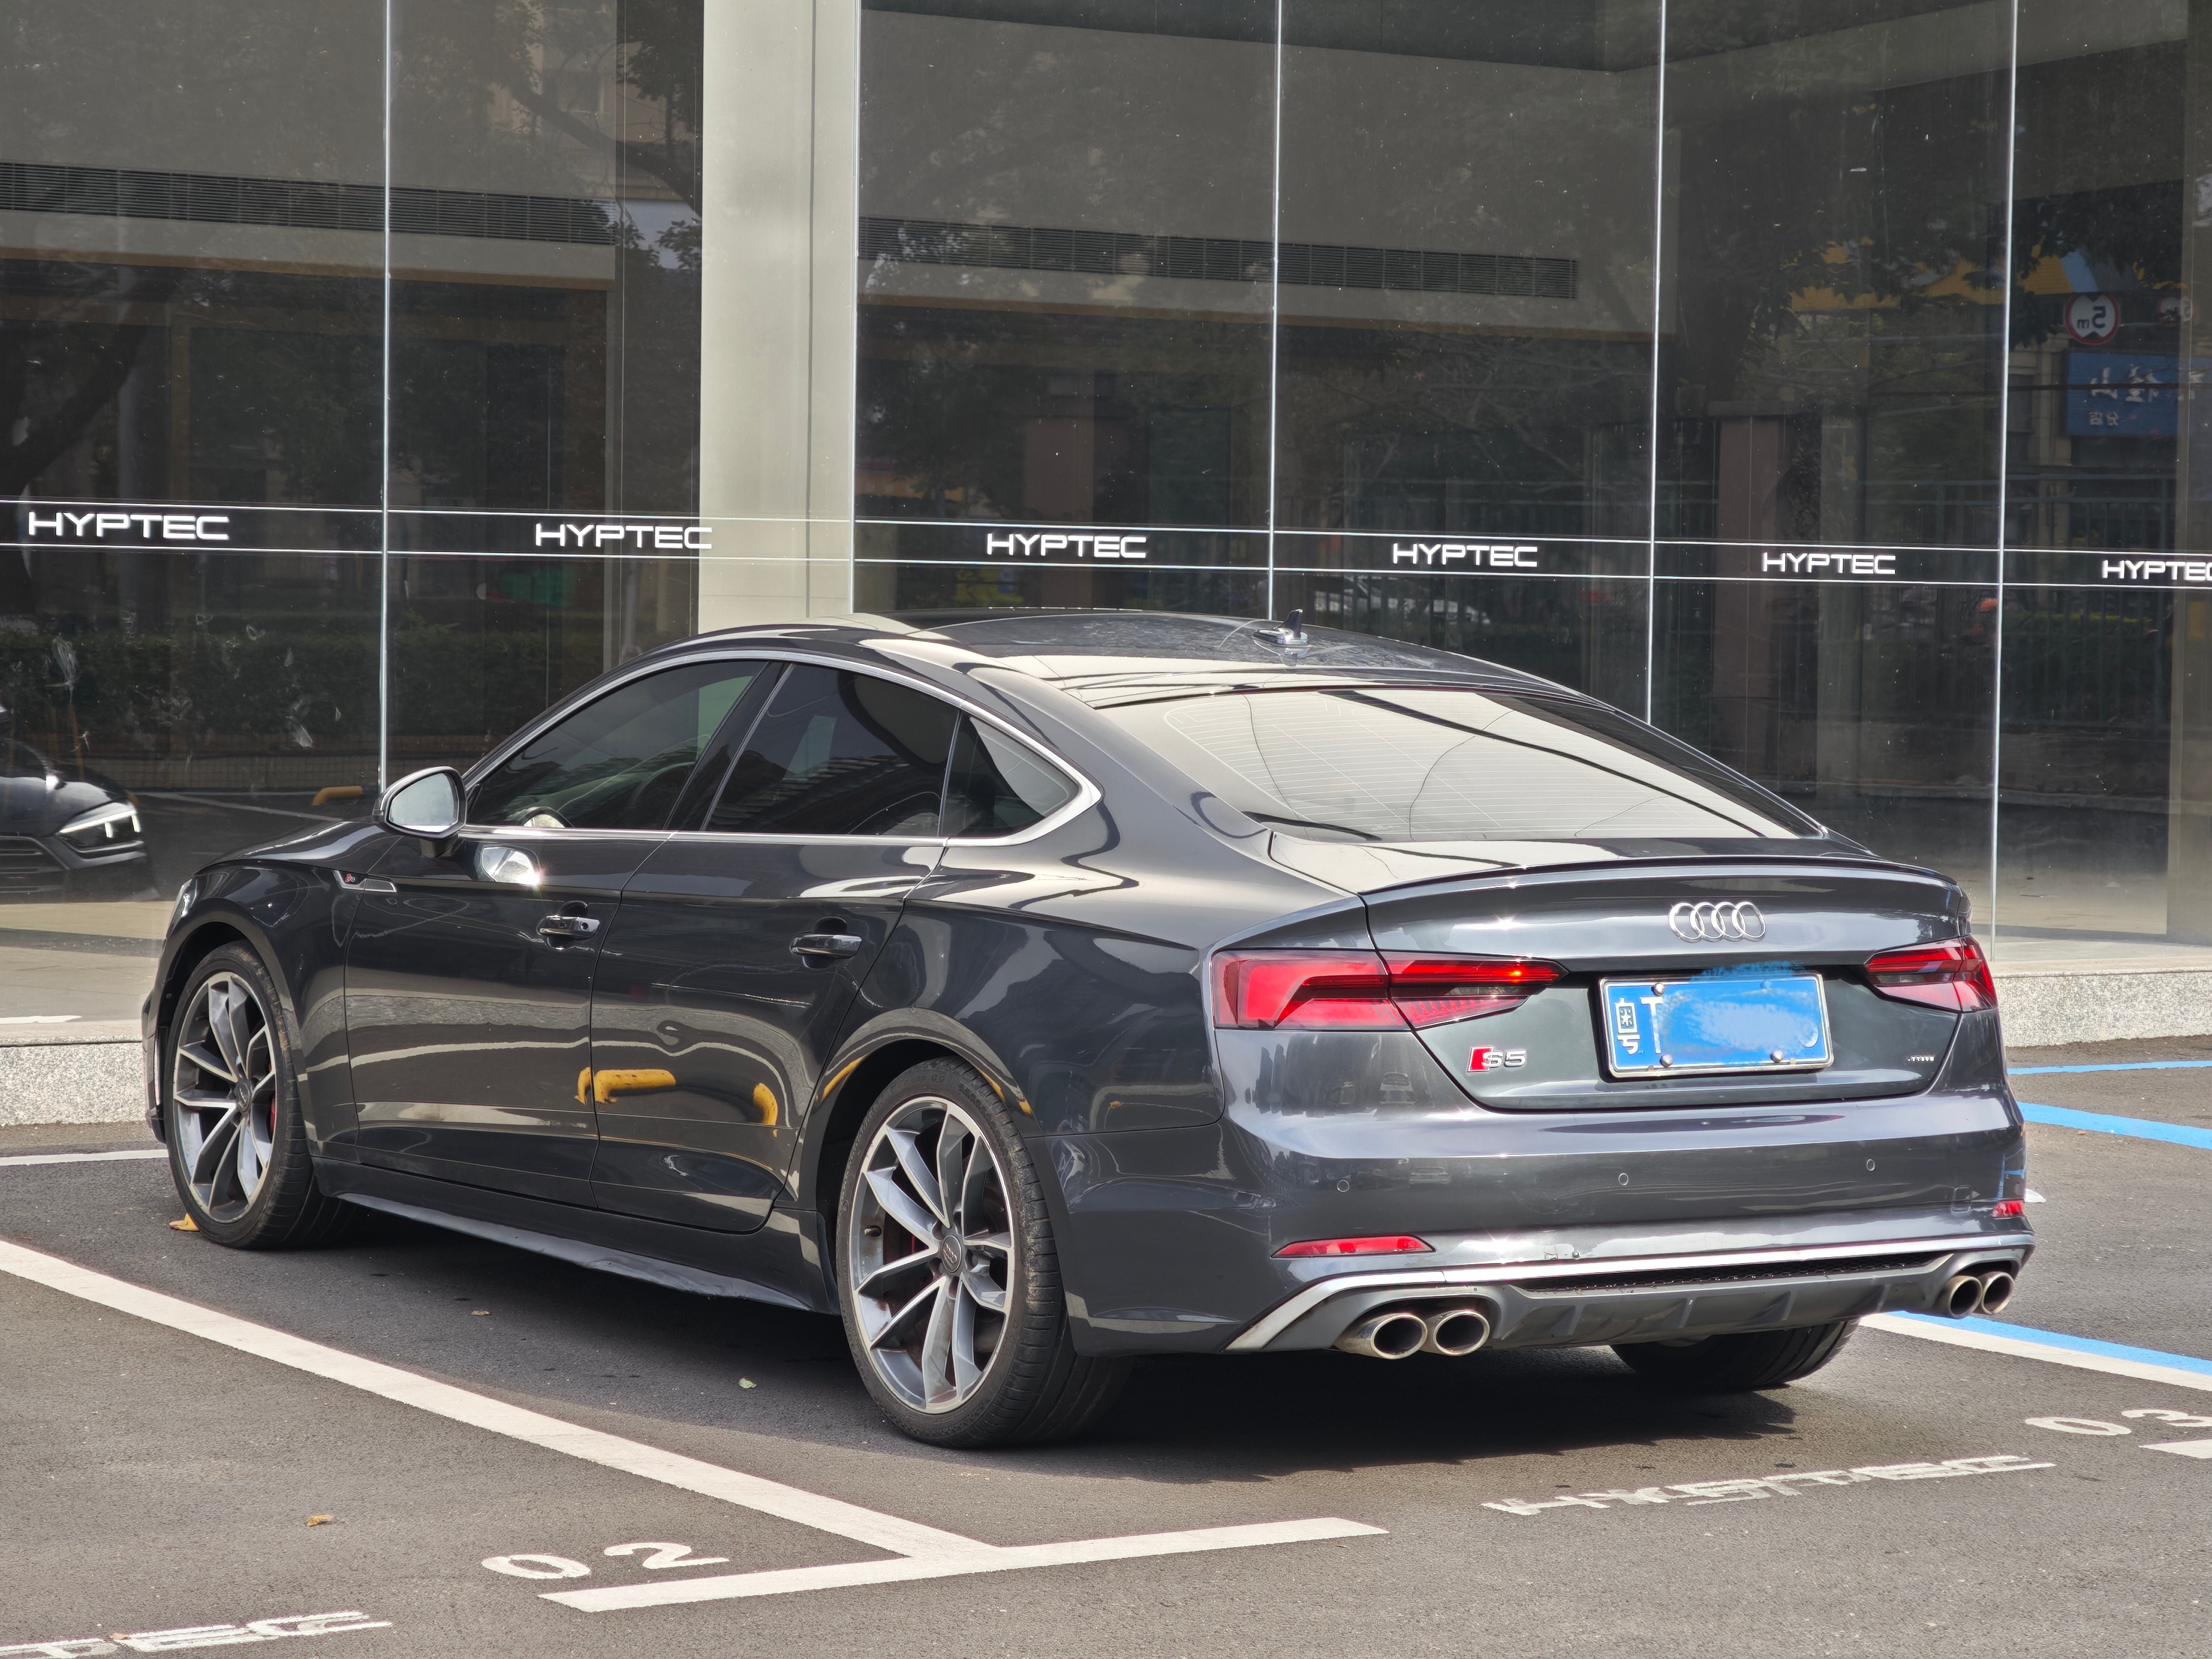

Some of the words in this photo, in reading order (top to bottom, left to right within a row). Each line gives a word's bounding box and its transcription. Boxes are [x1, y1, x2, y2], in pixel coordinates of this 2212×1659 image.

[28, 511, 230, 541] HYPTEC
[535, 523, 713, 549] HYPTEC
[987, 532, 1147, 559] HYPTEC
[1392, 543, 1538, 568] HYPTEC
[1762, 551, 1897, 575] HYPTEC
[2102, 559, 2212, 581] HYPTE
[1480, 1050, 1527, 1068] S5
[480, 1542, 730, 1580] 02
